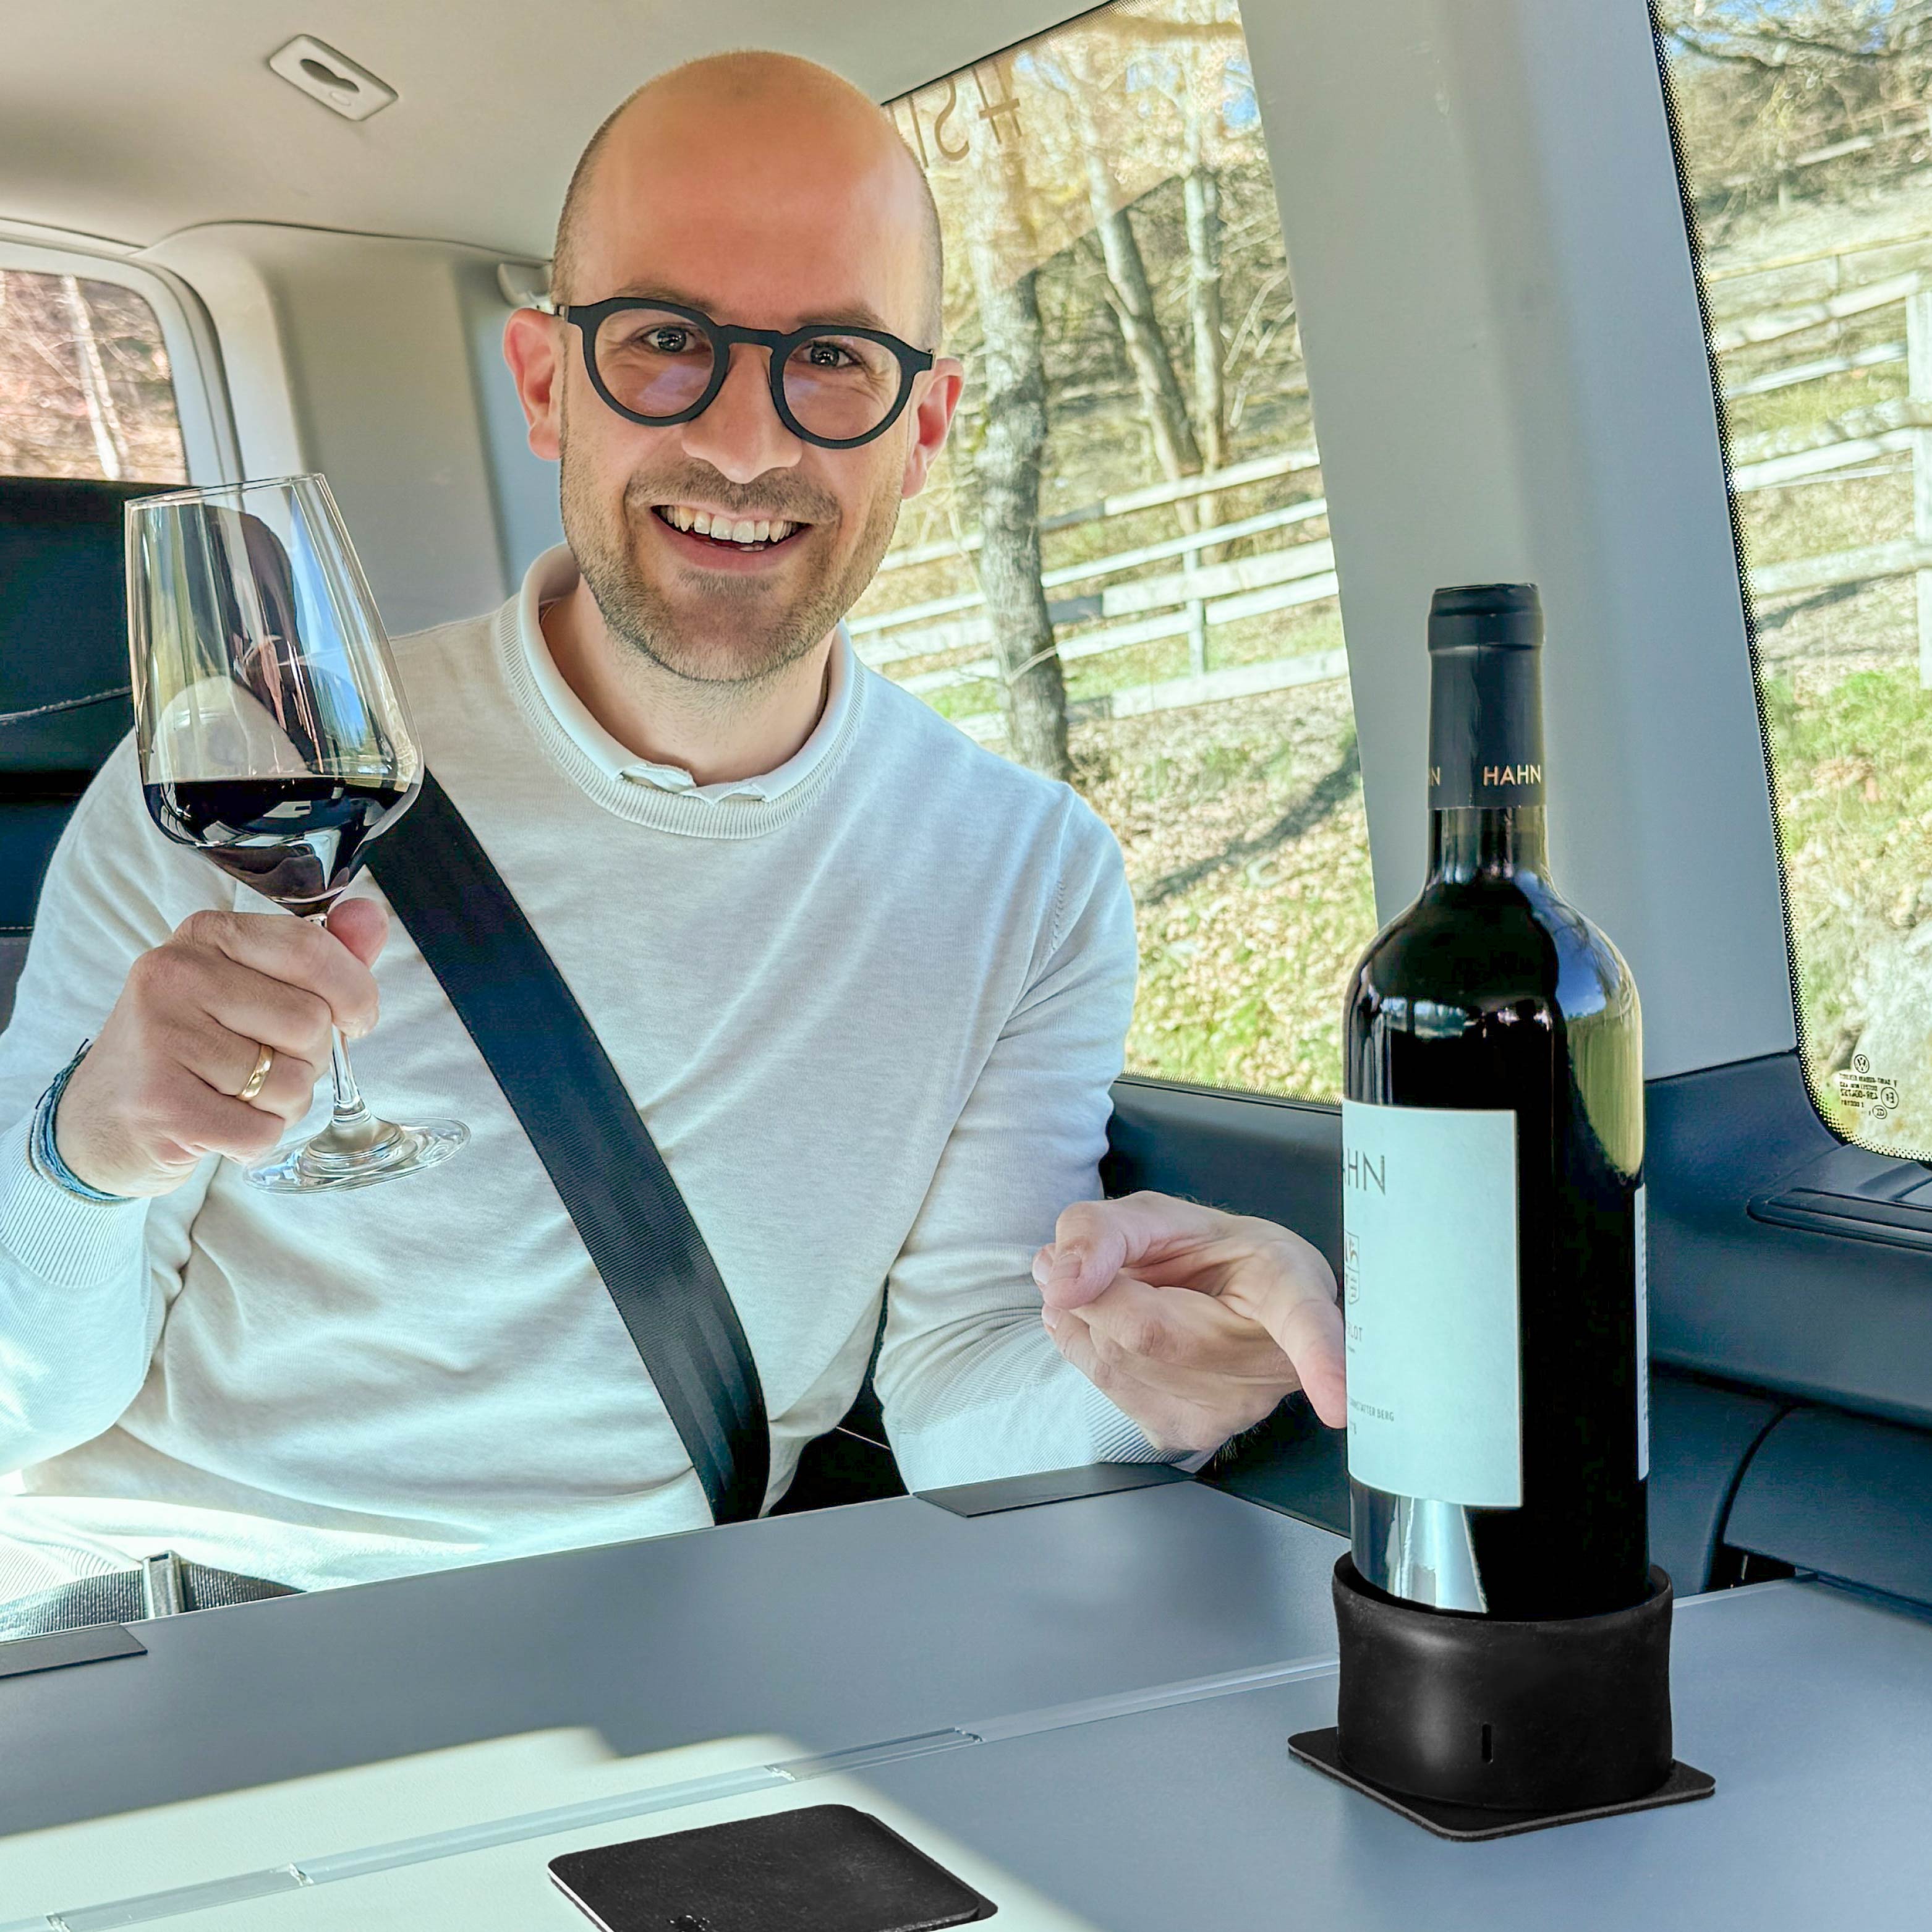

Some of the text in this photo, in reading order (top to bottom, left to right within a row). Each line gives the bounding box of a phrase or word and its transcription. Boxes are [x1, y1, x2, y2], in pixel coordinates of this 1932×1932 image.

[1483, 764, 1541, 786] HAHN
[1343, 1147, 1385, 1196] HN
[1377, 1408, 1394, 1421] BERG
